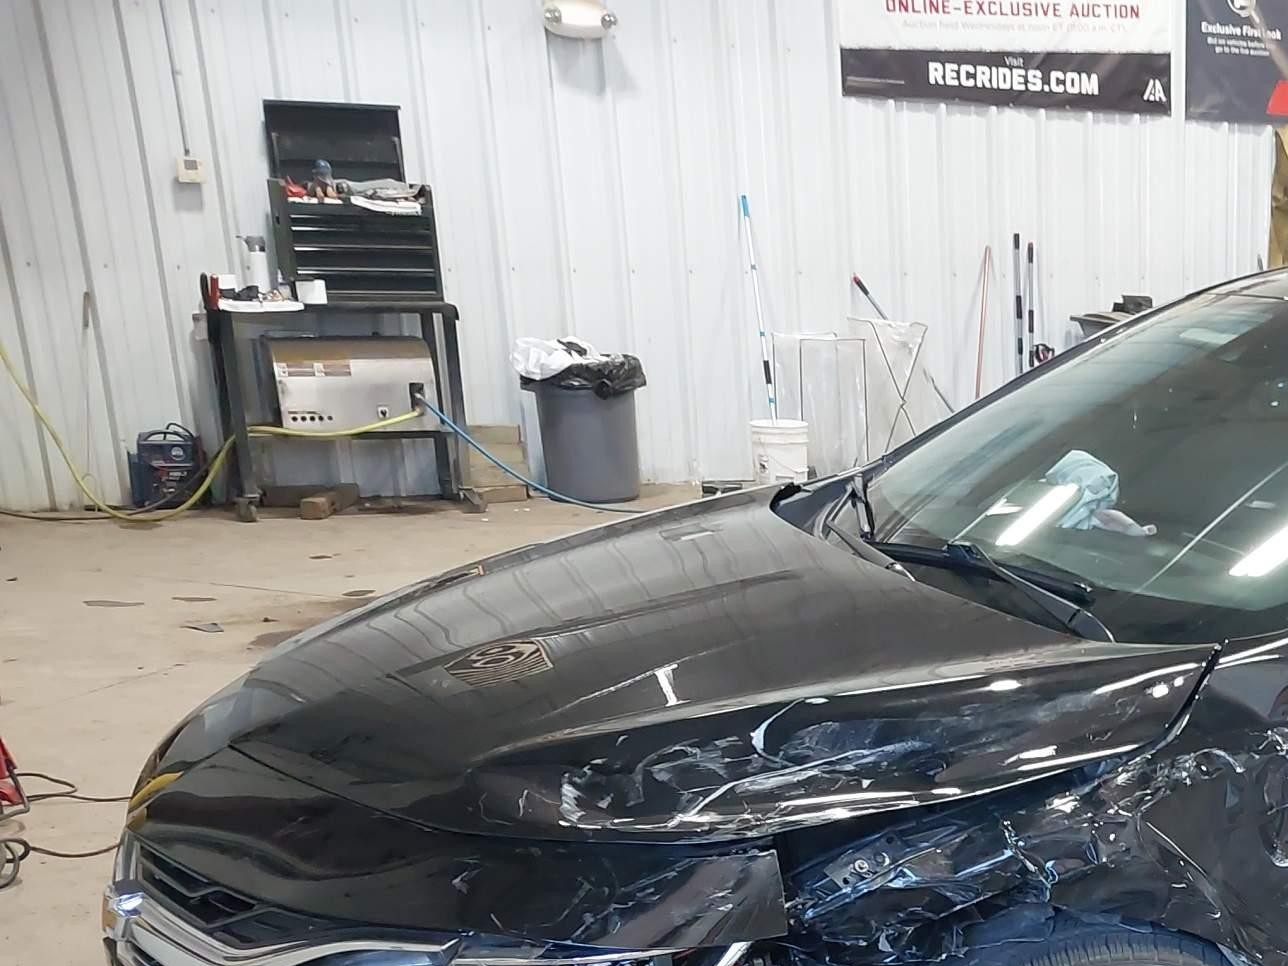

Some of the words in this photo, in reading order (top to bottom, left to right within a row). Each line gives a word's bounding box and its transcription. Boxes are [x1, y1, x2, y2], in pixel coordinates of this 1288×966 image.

[886, 0, 1061, 18] ONLINE-EXCLUSIVE
[1069, 3, 1141, 19] AUCTION
[1201, 21, 1242, 36] Exclusive
[1242, 25, 1261, 38] First
[1003, 55, 1024, 68] Visit
[928, 61, 1100, 96] RECRIDES.COM
